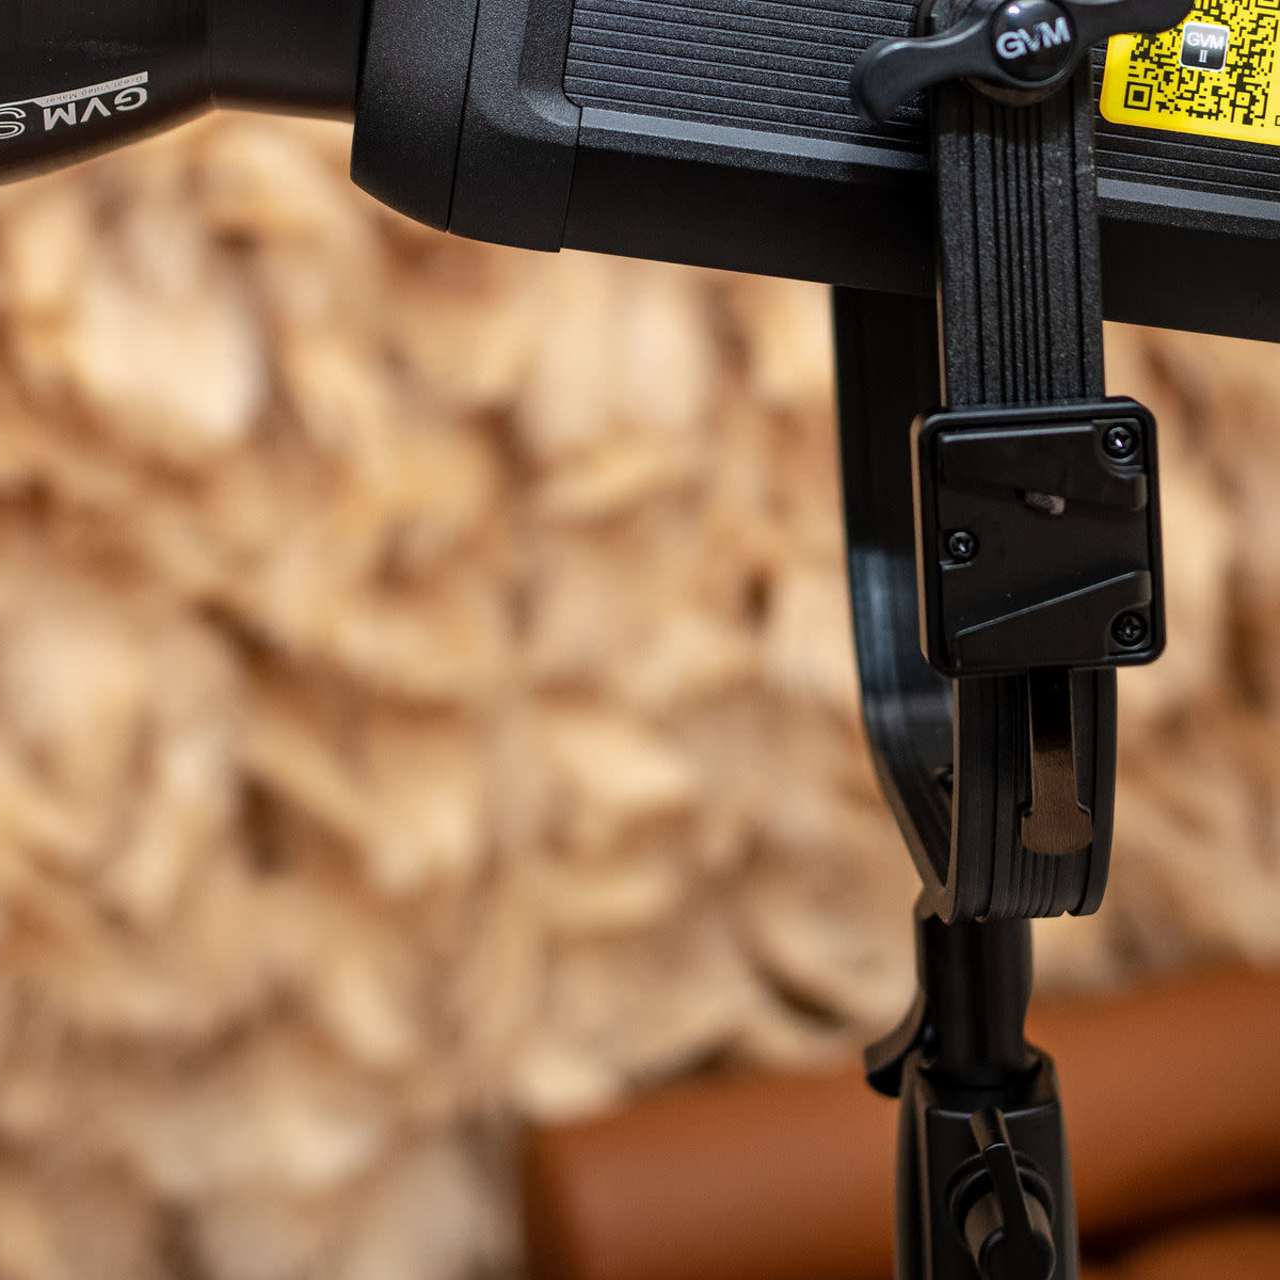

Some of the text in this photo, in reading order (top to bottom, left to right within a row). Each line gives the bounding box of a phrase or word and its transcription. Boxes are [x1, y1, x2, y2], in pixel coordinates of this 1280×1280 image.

[996, 16, 1071, 60] GVM
[1186, 31, 1225, 50] GVM
[43, 86, 148, 131] GVM
